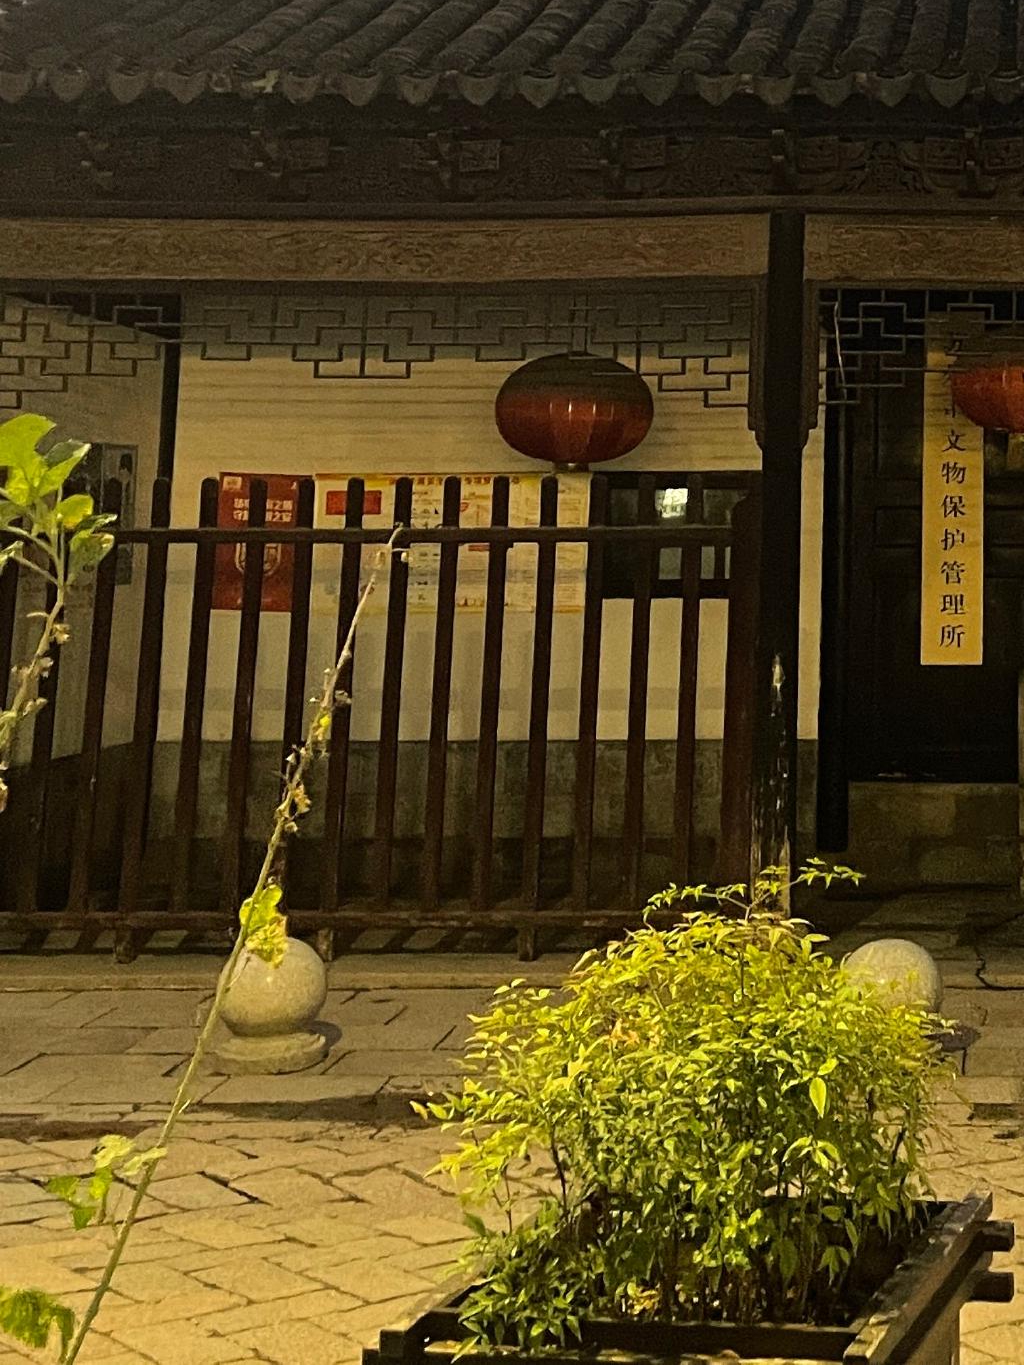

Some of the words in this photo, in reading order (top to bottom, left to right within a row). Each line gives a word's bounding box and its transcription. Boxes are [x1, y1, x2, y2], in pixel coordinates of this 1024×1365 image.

[939, 331, 966, 648] 文物保护管理所
